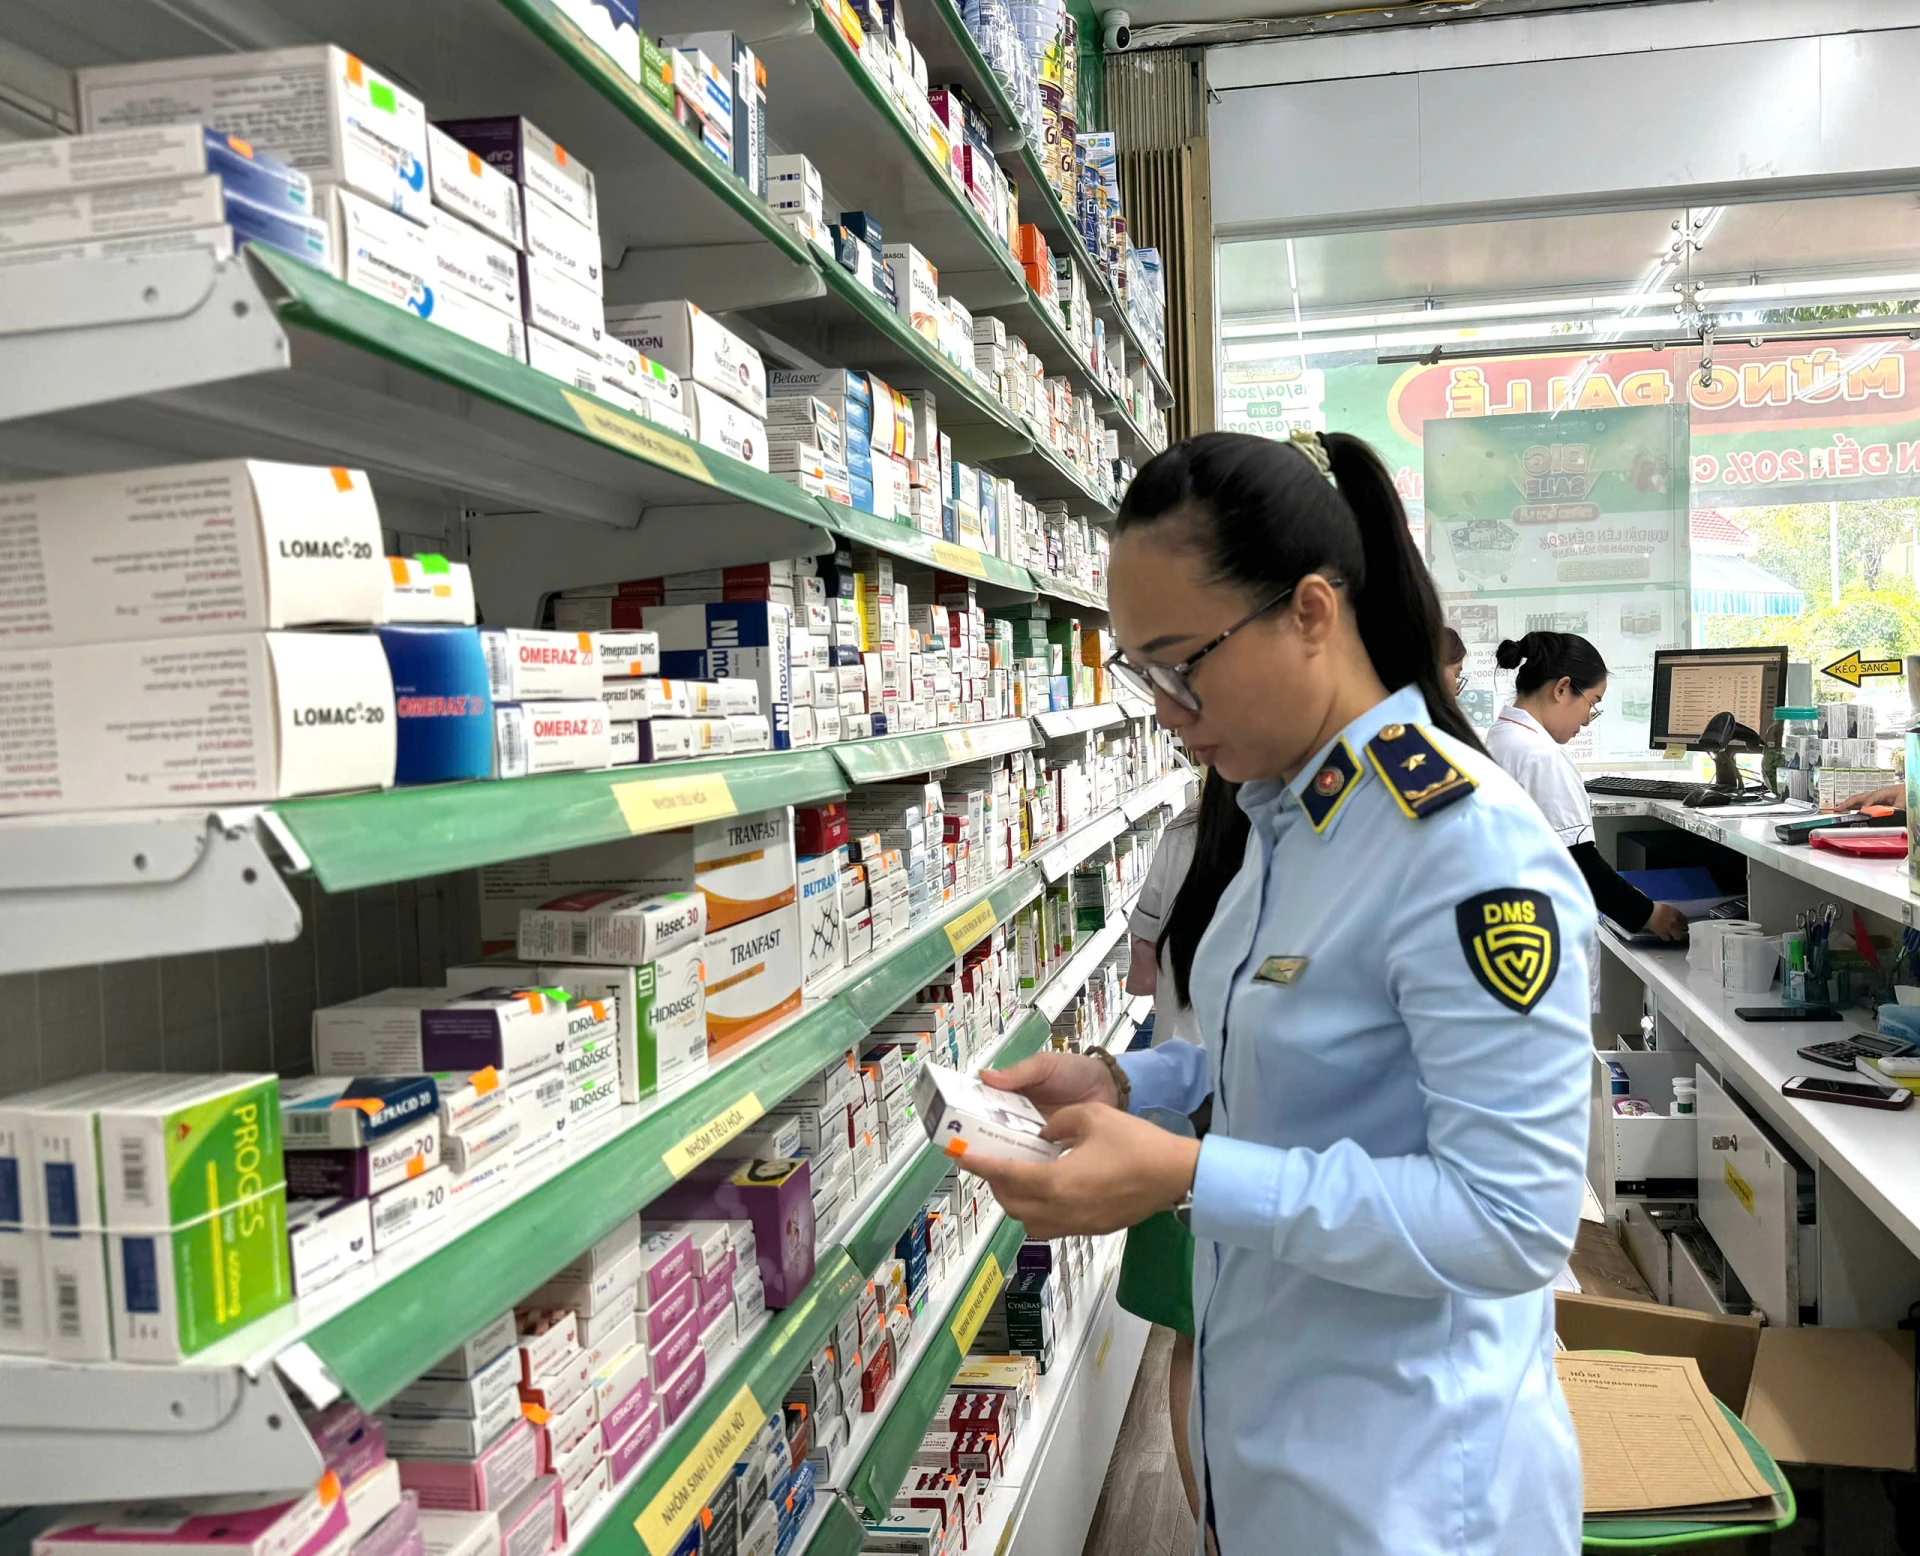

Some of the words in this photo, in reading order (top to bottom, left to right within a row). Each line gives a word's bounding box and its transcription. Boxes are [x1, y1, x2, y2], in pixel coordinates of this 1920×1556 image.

[884, 252, 906, 260] BASOL
[624, 335, 663, 349] Nexiu
[519, 645, 577, 665] OMERAZ
[640, 643, 655, 655] DHG
[1835, 662, 1858, 674] KÉO
[1860, 663, 1889, 672] SANG
[602, 688, 629, 702] eprazol
[533, 719, 588, 738] OMERAZ
[728, 818, 781, 847] TRANFAST
[656, 914, 685, 940] Hasec
[686, 906, 699, 926] 30
[1483, 900, 1536, 924] DMS
[731, 928, 781, 965] TRANFAST
[649, 992, 697, 1027] HIDRASEC
[416, 1135, 434, 1156] 20
[684, 1134, 712, 1159] NHÓM
[711, 1120, 729, 1141] TIÊU
[728, 1109, 745, 1131] HÓA
[234, 1103, 266, 1239] PROGES
[427, 1185, 444, 1209] 20
[661, 1486, 692, 1527] NHÓM
